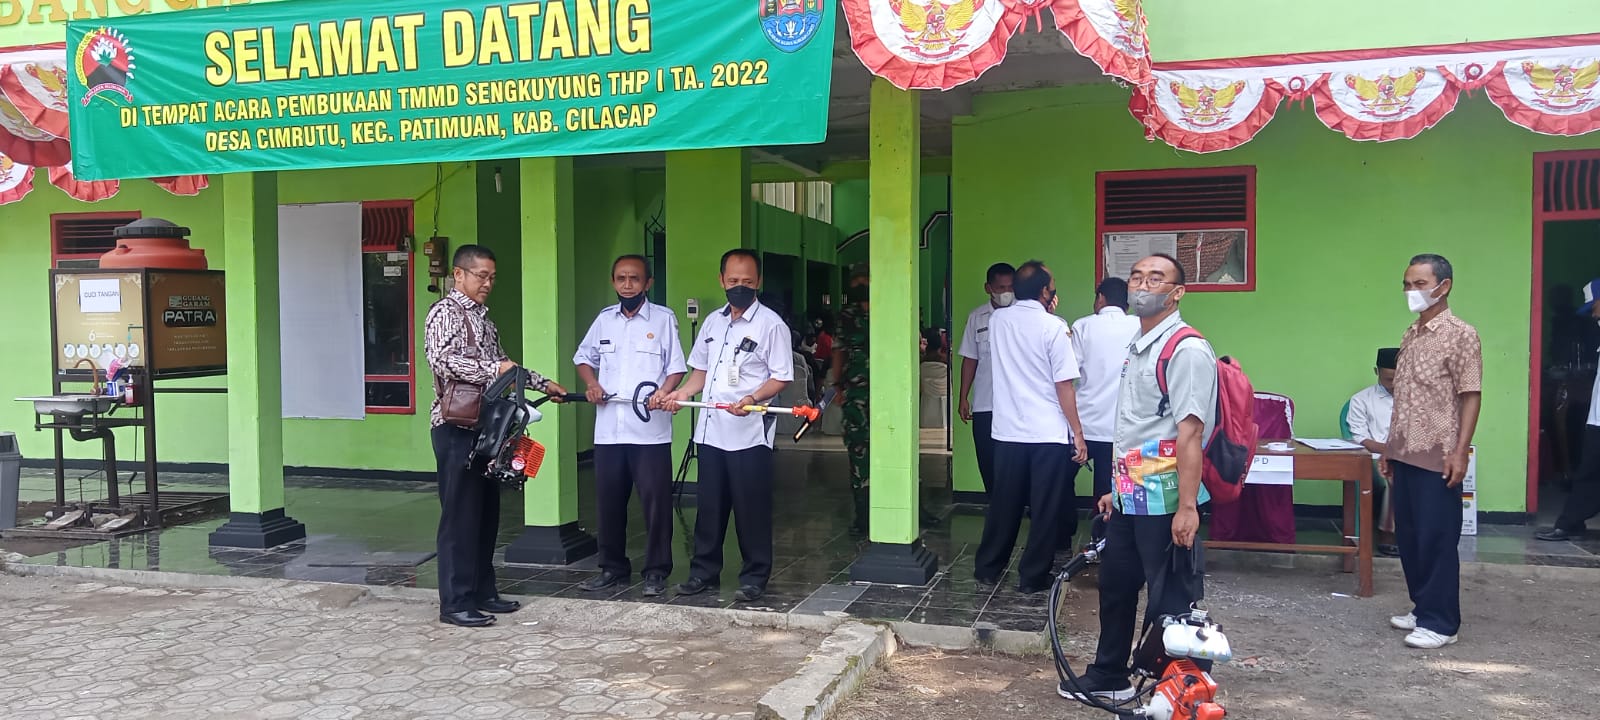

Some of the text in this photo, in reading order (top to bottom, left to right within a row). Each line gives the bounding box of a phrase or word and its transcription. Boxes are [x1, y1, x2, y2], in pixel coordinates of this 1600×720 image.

[204, 0, 651, 87] SELAMAT DATANG
[120, 59, 768, 128] DI TEMPAT ACARA PEMBUKAAN TMMD SENGKUYUNG THP I TA. 2022
[205, 103, 657, 152] DESA CIMRUTU, KEC. PATIMUAN, KAB. CILACAP
[165, 310, 216, 322] PATRA
